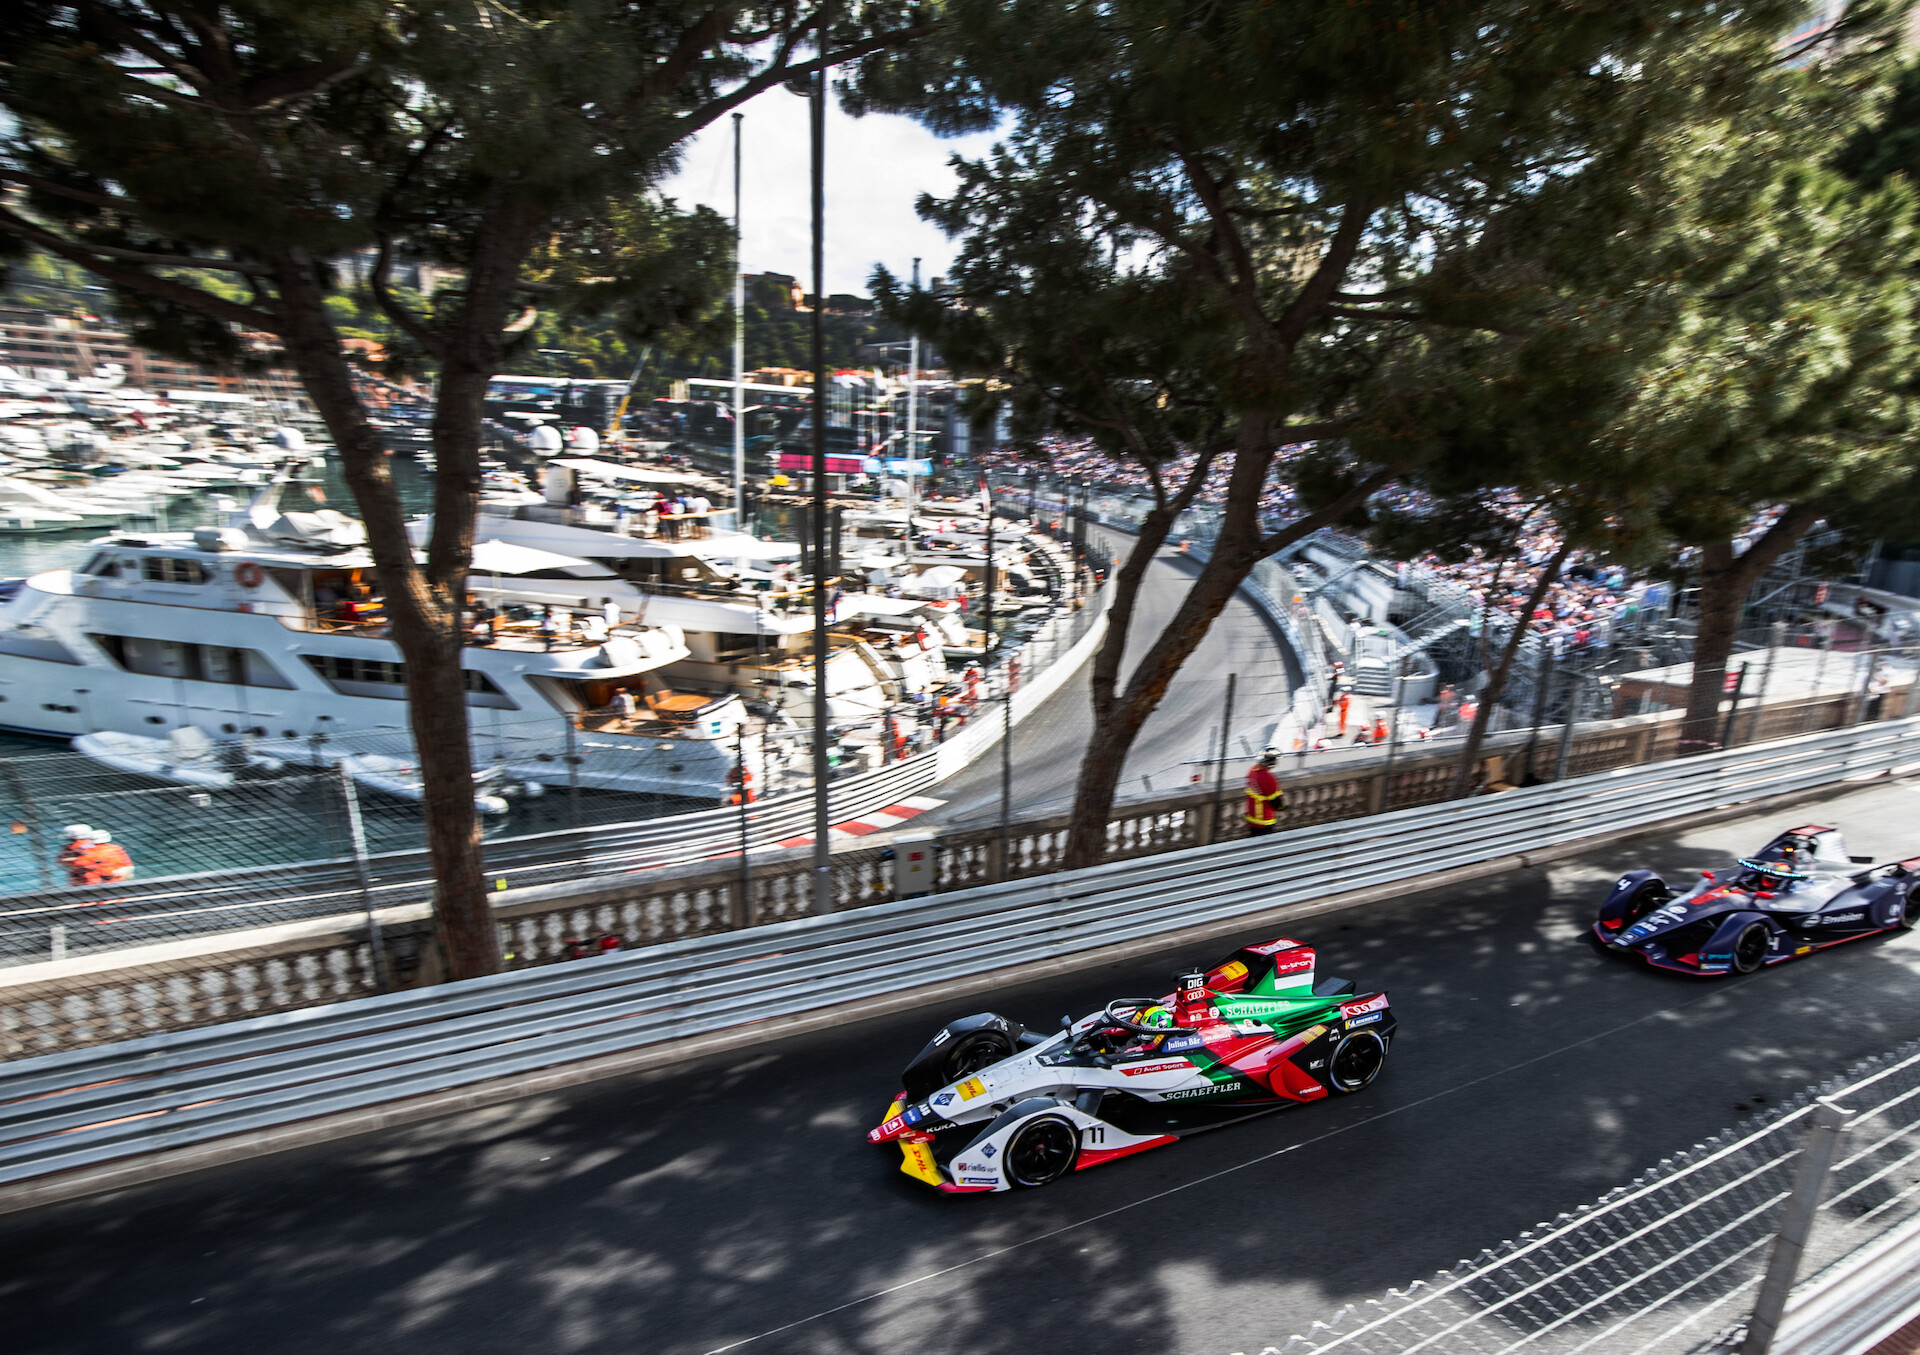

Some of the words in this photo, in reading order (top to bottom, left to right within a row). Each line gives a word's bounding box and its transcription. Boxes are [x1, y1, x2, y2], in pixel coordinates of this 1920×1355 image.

[1617, 879, 1632, 890] 4
[1280, 960, 1312, 970] e-tron
[1187, 978, 1204, 989] DIG
[1226, 1001, 1291, 1016] SCHAEFFLER
[933, 1028, 951, 1047] 11
[1167, 1040, 1188, 1050] Julius
[1188, 1037, 1201, 1045] Bär
[1143, 1065, 1161, 1073] Audi
[1162, 1062, 1184, 1070] Sport
[963, 1080, 977, 1098] DHL
[1166, 1082, 1241, 1100] SCHAEFFLER
[926, 1122, 957, 1133] KUKA
[1089, 1127, 1105, 1143] 11
[911, 1148, 928, 1172] DHL
[967, 1162, 986, 1172] riello
